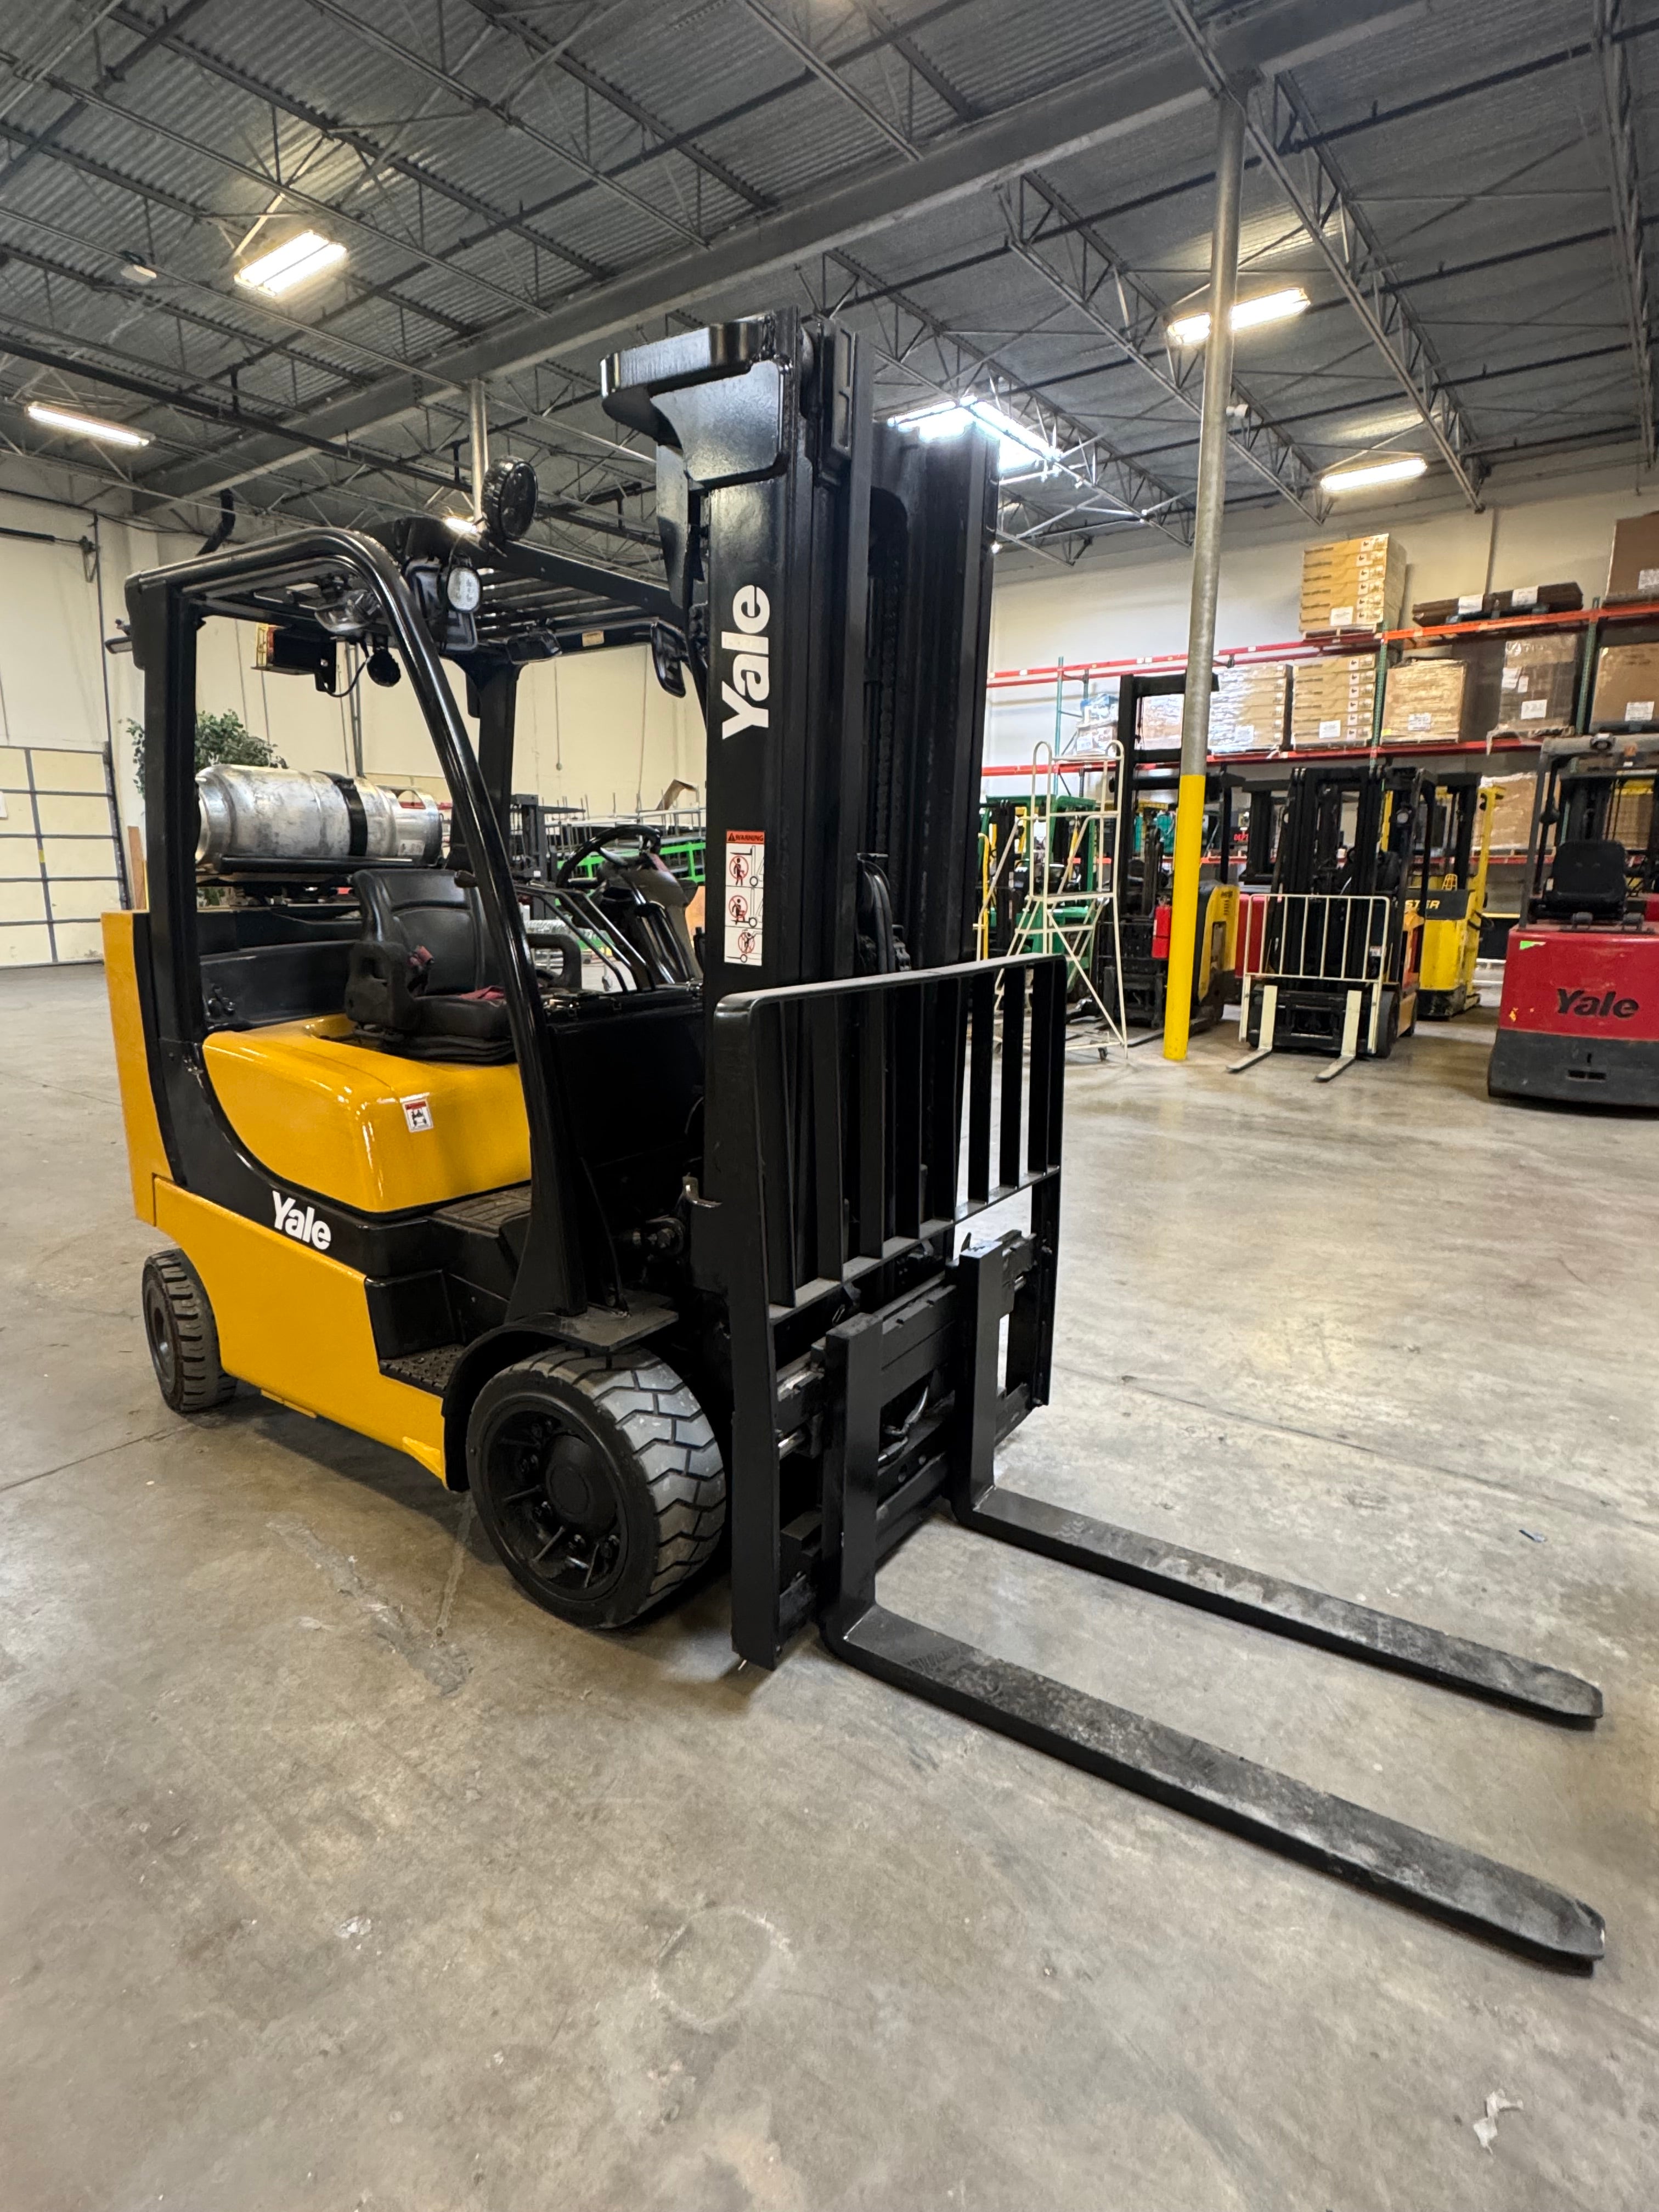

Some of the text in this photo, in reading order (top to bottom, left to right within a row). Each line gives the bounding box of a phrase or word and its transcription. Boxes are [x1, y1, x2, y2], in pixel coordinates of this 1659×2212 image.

[721, 585, 770, 740] Yale
[1557, 988, 1639, 1018] Yale
[272, 1190, 331, 1250] Yale
